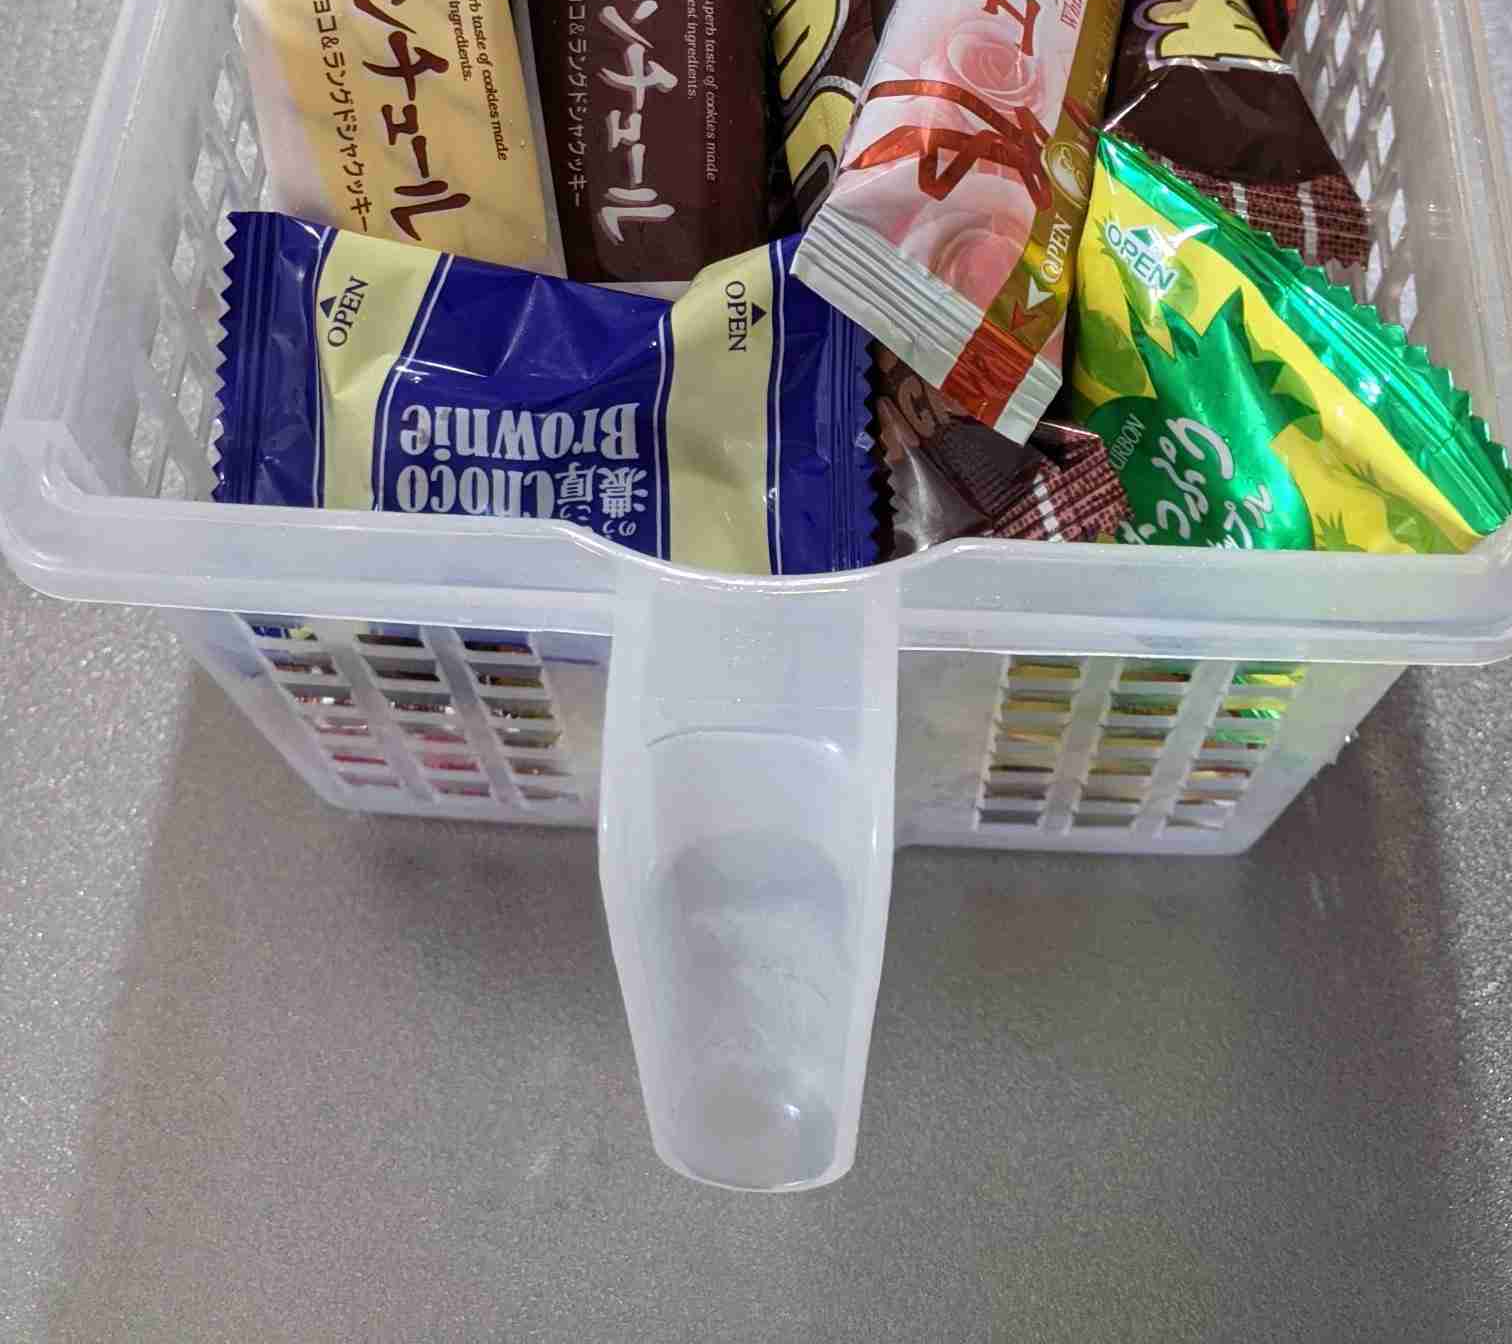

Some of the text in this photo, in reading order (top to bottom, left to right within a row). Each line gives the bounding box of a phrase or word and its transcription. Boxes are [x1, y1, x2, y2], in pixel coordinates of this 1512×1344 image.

[473, 16, 487, 48] taste
[704, 39, 718, 73] taste
[477, 51, 490, 66] of
[703, 76, 718, 90] of
[482, 69, 498, 121] cookies
[705, 92, 719, 140] cookies
[491, 120, 508, 161] made
[706, 143, 719, 182] made
[1040, 213, 1073, 285] OPEN
[1108, 224, 1176, 290] OPEN
[327, 277, 369, 347] OPEN
[725, 281, 747, 352] OPEN
[400, 403, 640, 462] Brownie
[1110, 413, 1147, 471] URBON
[396, 460, 648, 519] 濃厚 Choco
